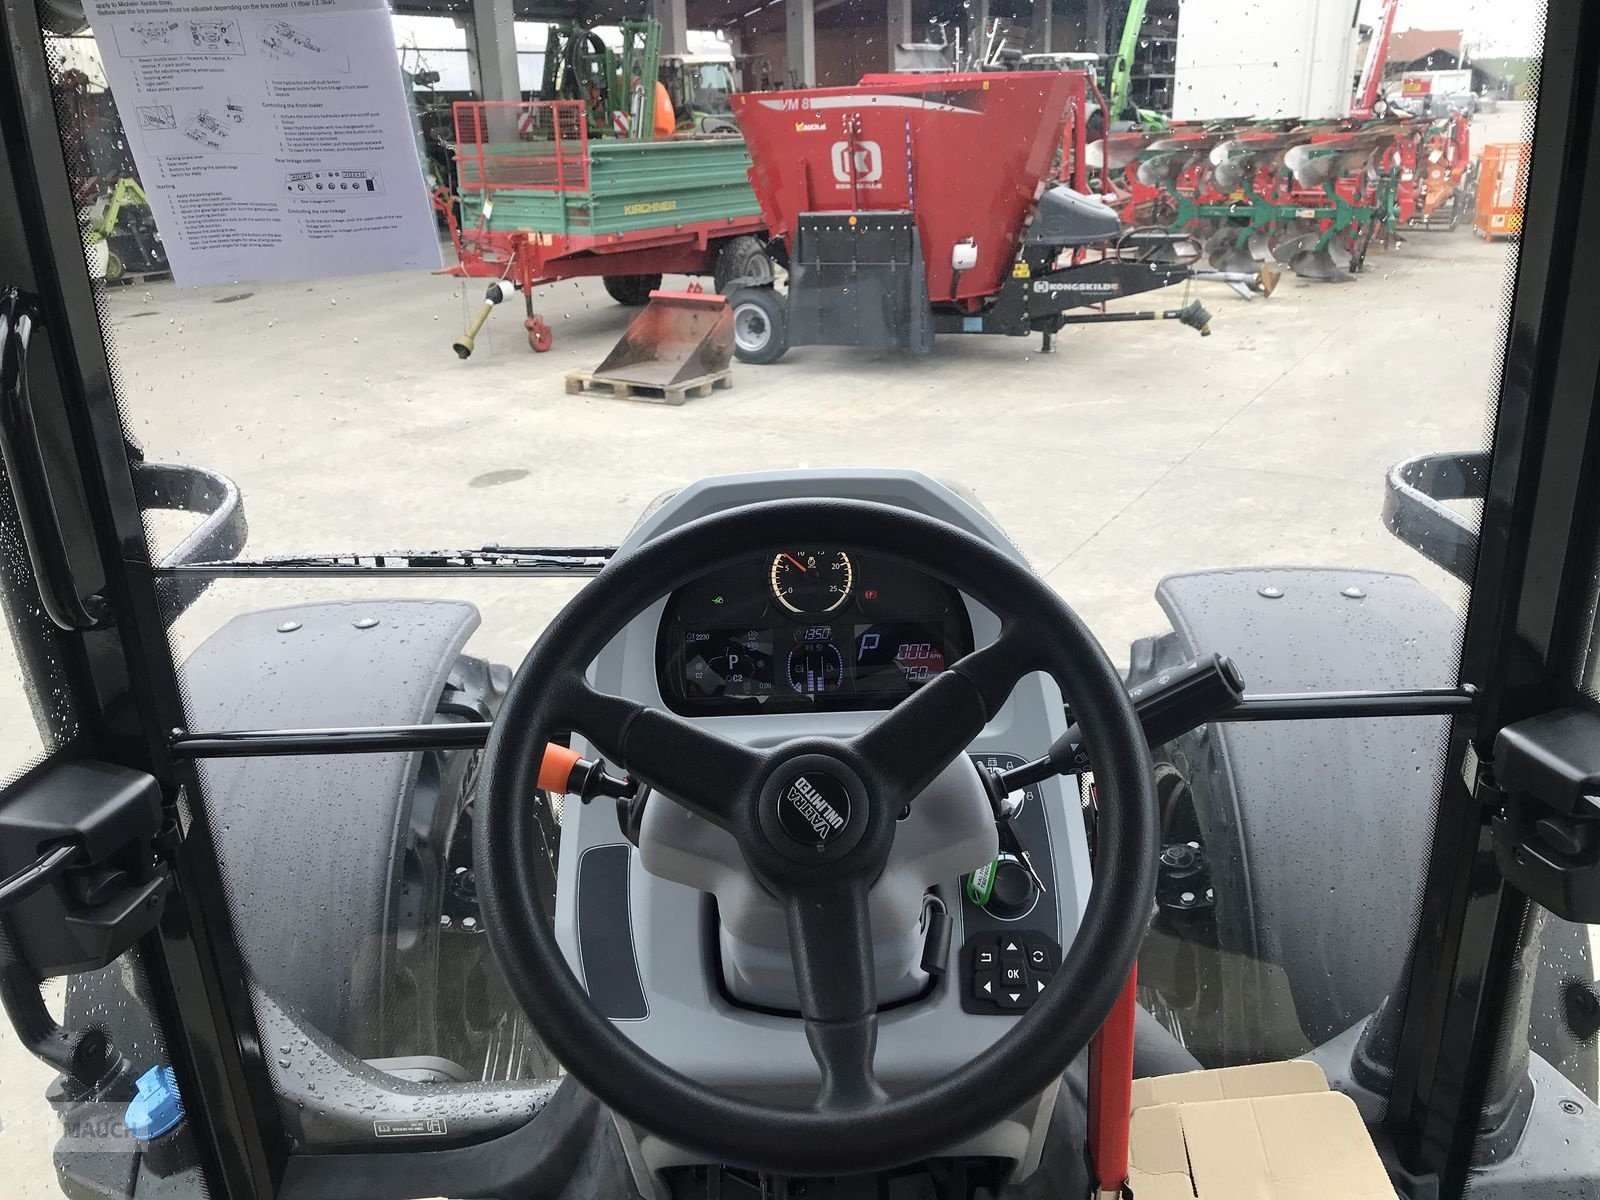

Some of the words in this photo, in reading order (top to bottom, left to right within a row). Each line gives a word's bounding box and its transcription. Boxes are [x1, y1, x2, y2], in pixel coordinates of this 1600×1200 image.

[802, 98, 809, 110] 8
[624, 200, 677, 216] KIRCHNER
[1049, 283, 1118, 291] KONGSKILDE
[804, 628, 830, 640] 1350
[858, 633, 880, 660] P
[896, 644, 930, 660] 000
[729, 654, 738, 669] P
[732, 674, 743, 682] C2
[902, 666, 928, 680] 750
[795, 777, 844, 829] UNLIMITED
[787, 786, 830, 839] VALTRA
[1007, 969, 1020, 979] OK
